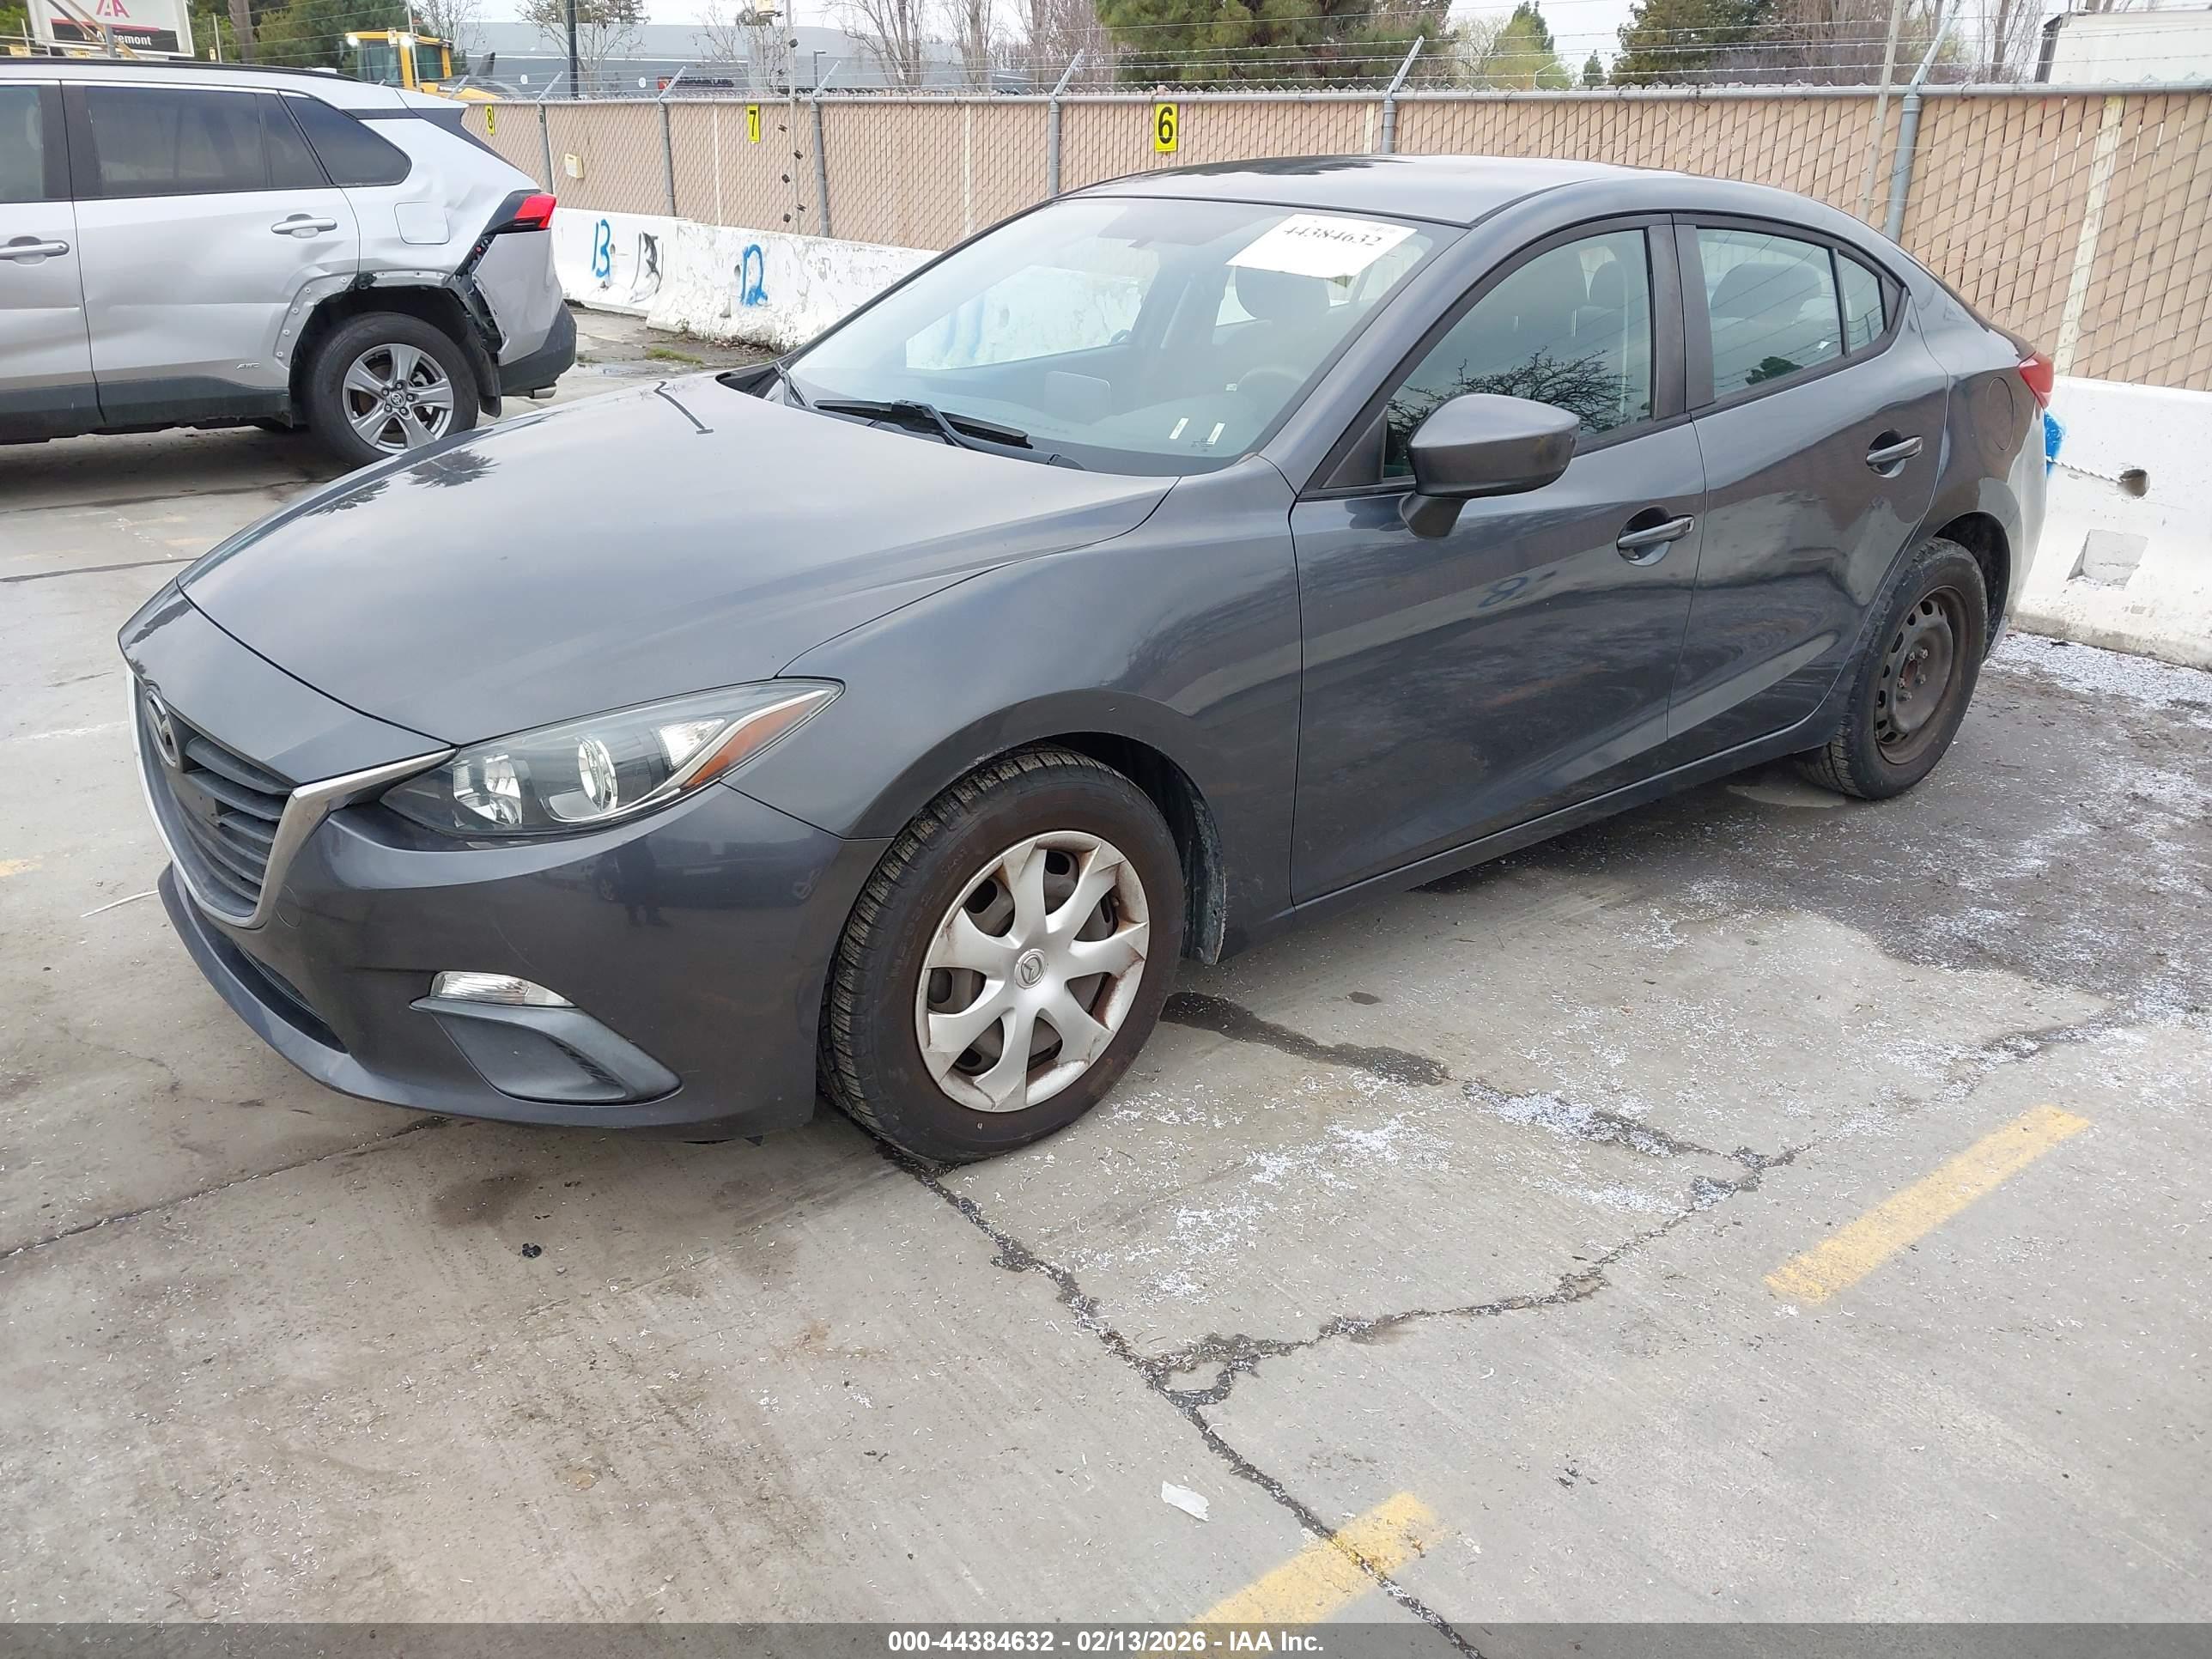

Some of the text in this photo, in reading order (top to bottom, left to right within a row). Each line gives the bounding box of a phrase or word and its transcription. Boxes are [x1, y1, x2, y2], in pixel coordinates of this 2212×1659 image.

[487, 108, 494, 130] 8
[749, 109, 757, 137] 7
[1158, 106, 1174, 144] 6
[1284, 226, 1383, 246] 44384632
